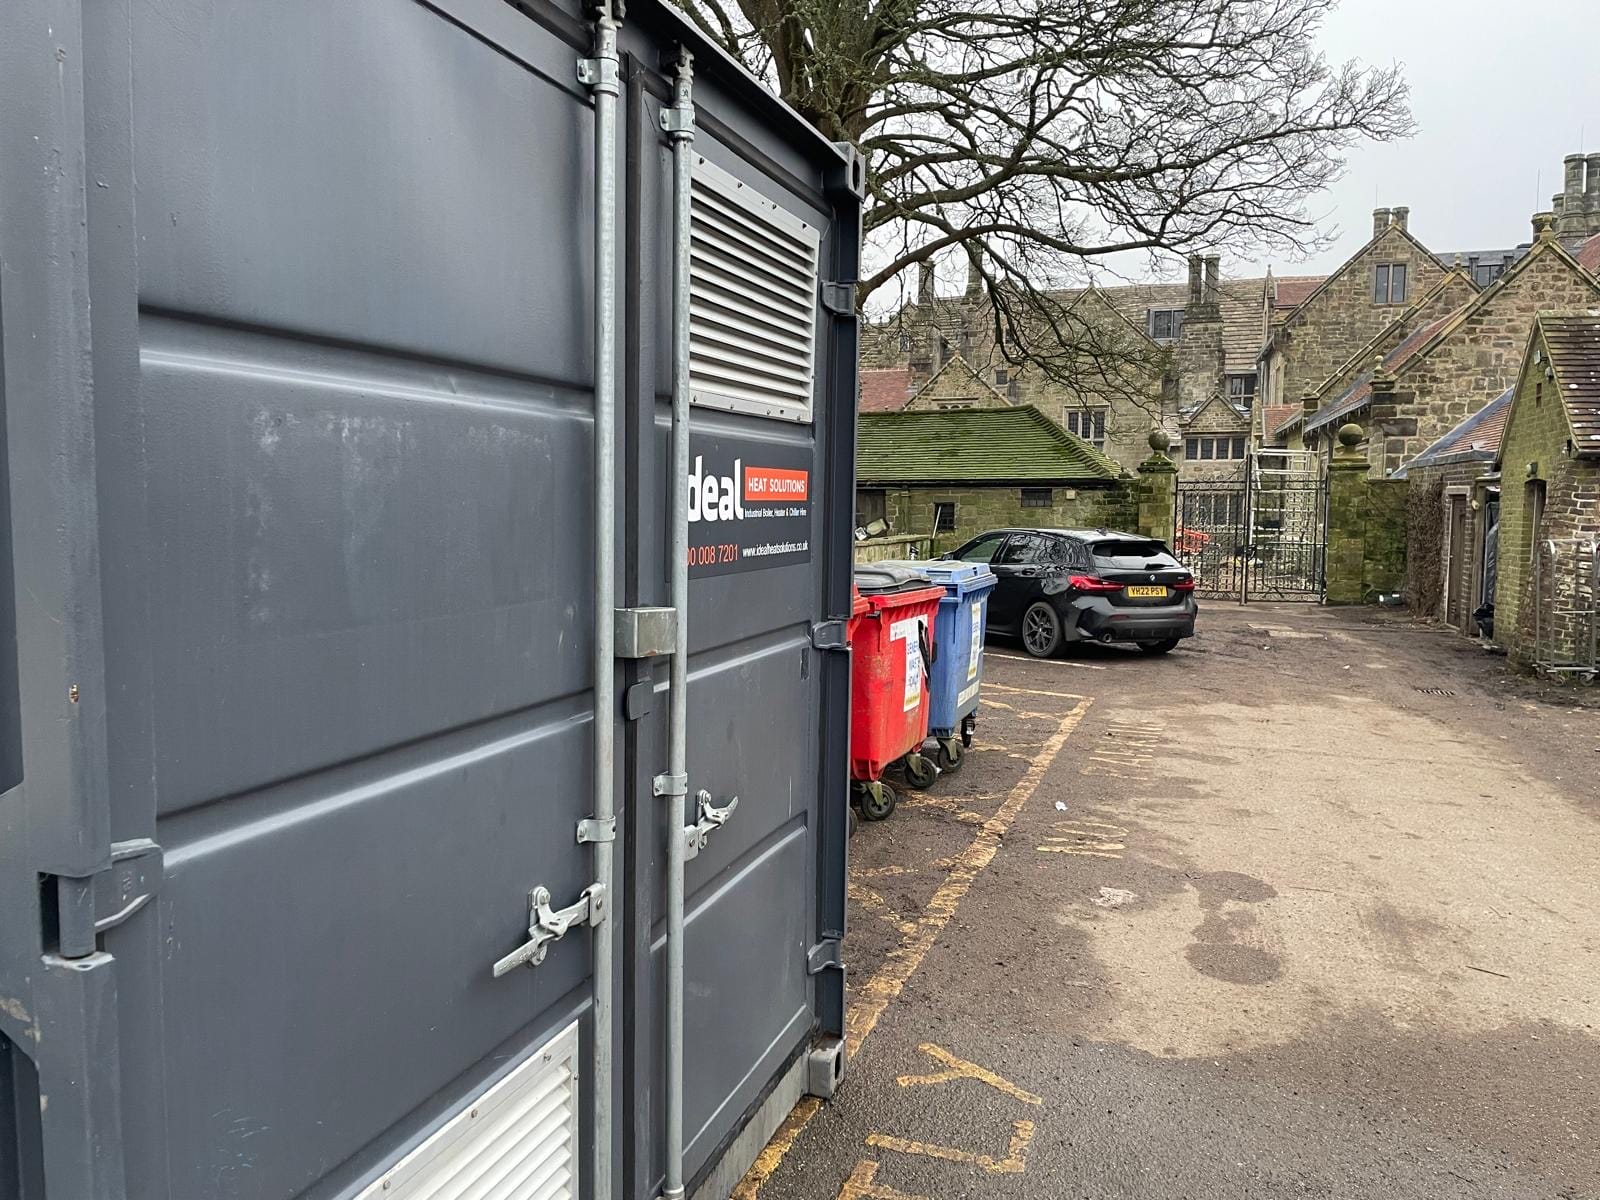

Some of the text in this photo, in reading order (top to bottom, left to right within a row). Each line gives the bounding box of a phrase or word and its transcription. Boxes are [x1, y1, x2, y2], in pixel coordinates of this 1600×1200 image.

[687, 455, 744, 522] deal
[748, 477, 805, 493] HEAT SOLUTIONS
[698, 545, 716, 565] 008
[718, 544, 738, 563] 7201
[742, 541, 808, 557] www.idealheatsolutions.co.uk
[1131, 587, 1164, 596] YH22 PSY
